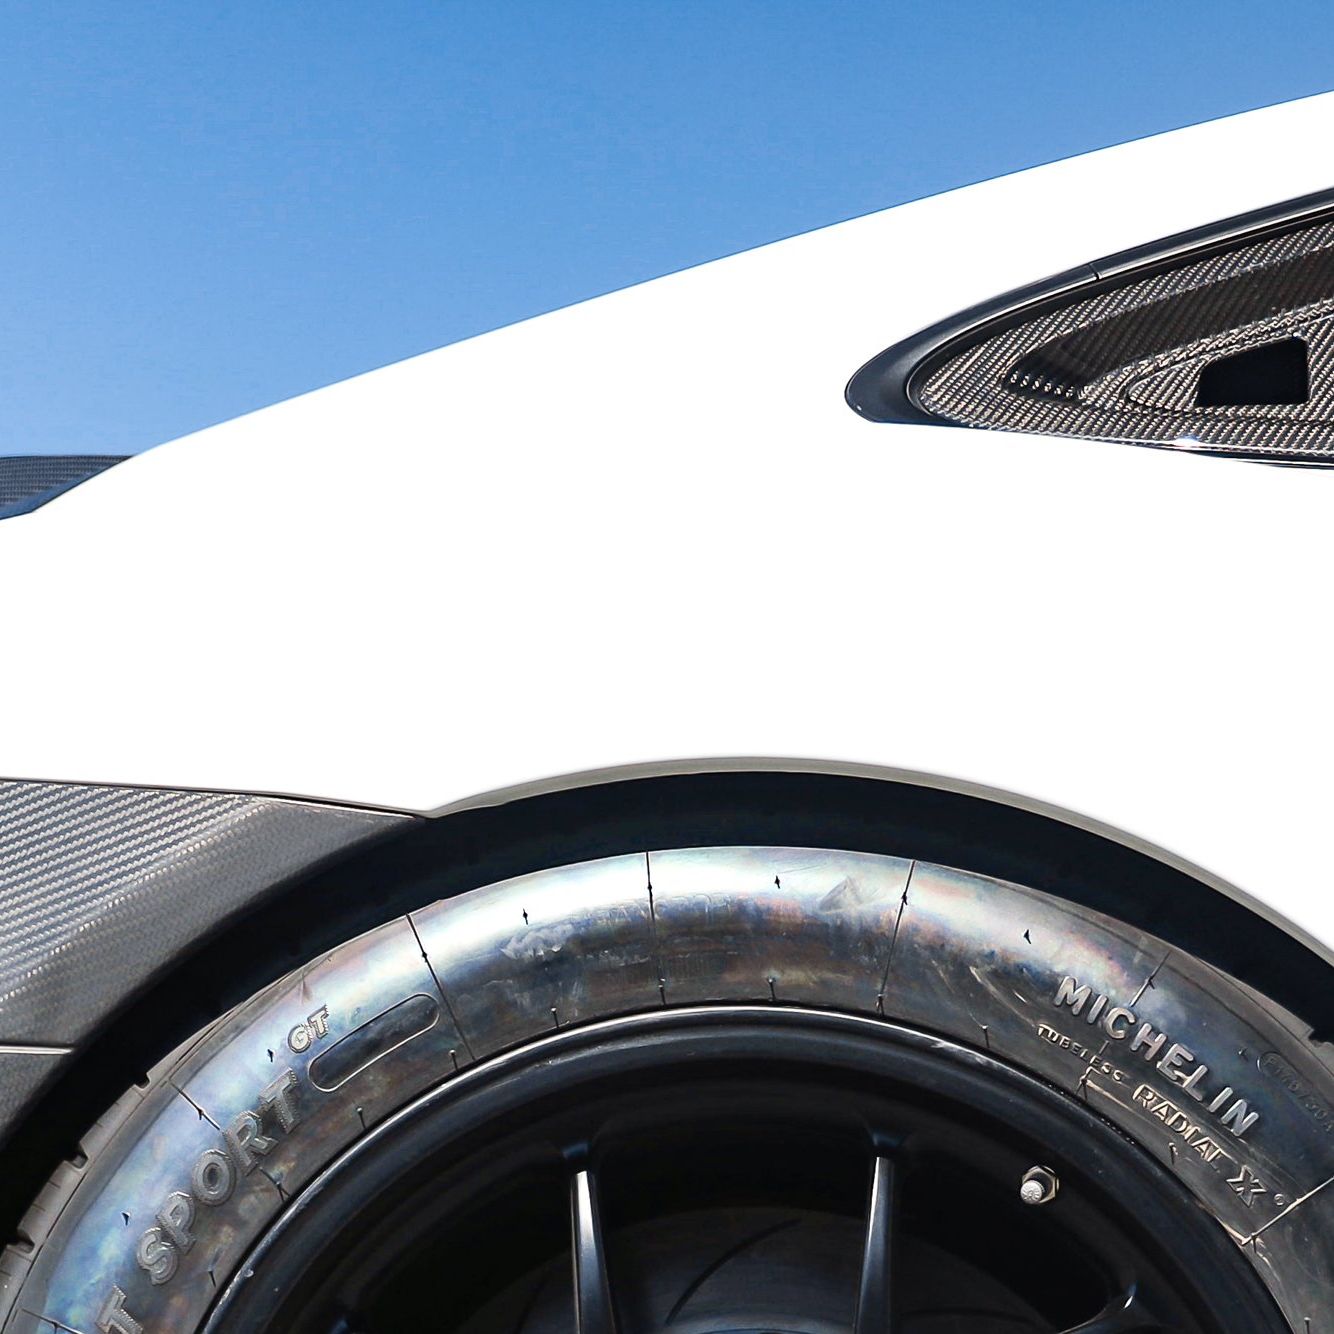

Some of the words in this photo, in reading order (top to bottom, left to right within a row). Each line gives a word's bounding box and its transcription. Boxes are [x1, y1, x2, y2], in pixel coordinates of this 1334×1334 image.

[287, 1004, 330, 1054] GT
[1037, 1023, 1124, 1082] TUBELESS
[1054, 976, 1259, 1137] MICHELIN
[1132, 1083, 1225, 1172] RADIAL
[135, 1067, 301, 1286] SPORT
